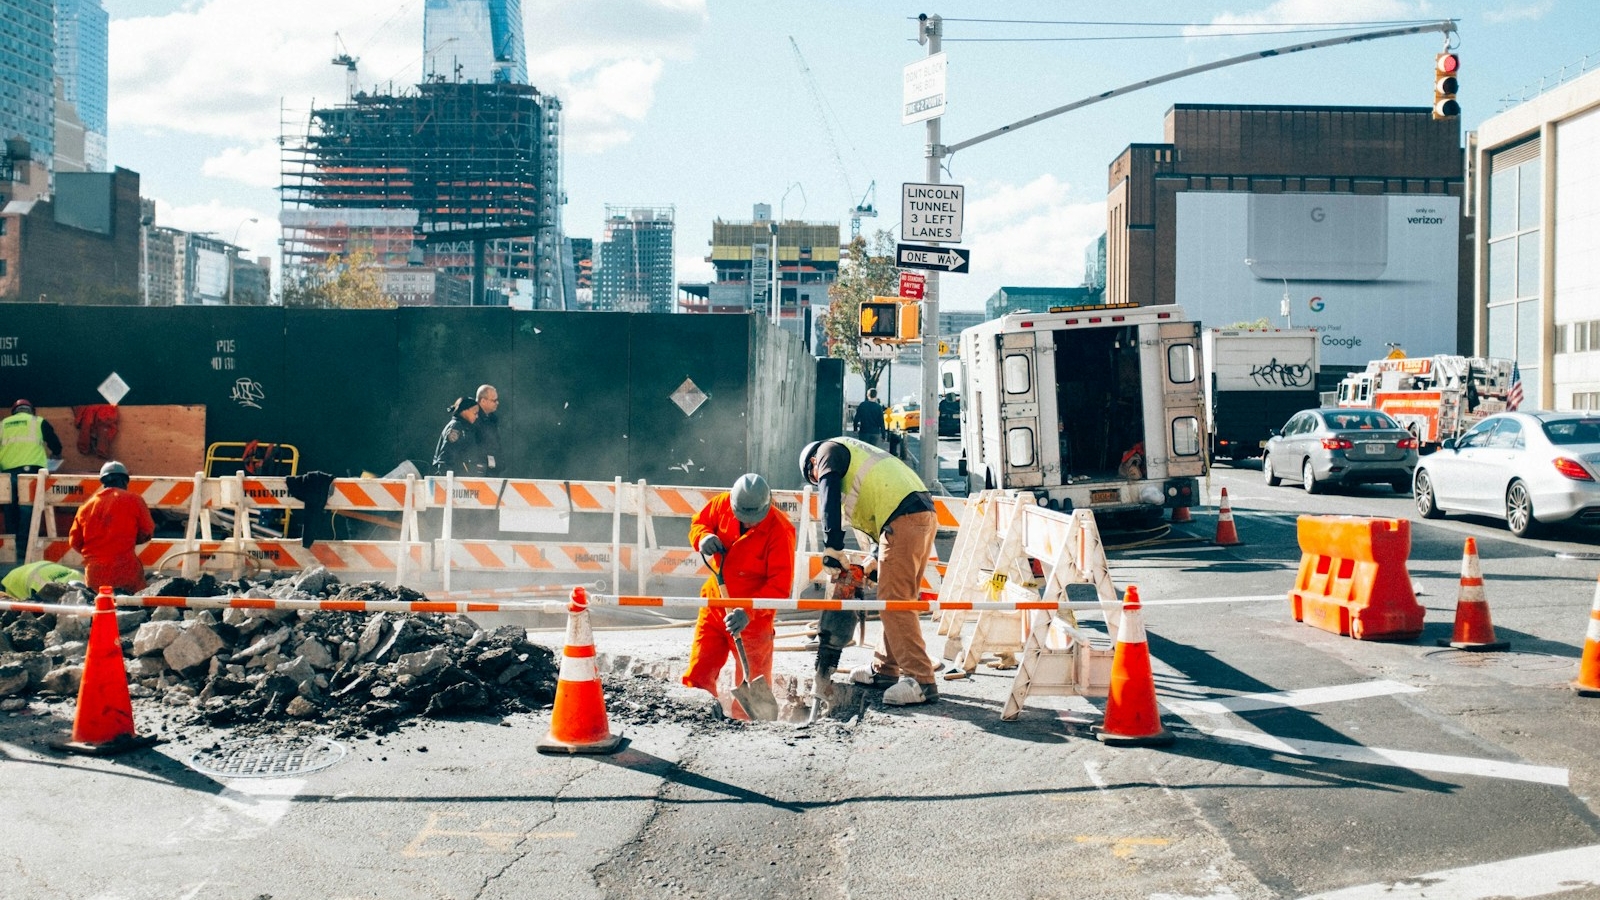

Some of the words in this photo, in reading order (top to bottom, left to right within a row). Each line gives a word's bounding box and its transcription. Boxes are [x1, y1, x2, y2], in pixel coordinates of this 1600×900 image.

[908, 188, 959, 199] LINCOLN
[909, 201, 957, 212] TUNNEL
[911, 214, 918, 223] 3
[925, 214, 954, 224] LEFT
[1310, 207, 1326, 222] G
[1407, 216, 1443, 224] verizon
[912, 227, 952, 237] LANES
[907, 252, 928, 262] ONE
[937, 254, 958, 265] WAY
[1309, 296, 1325, 312] G
[1322, 335, 1362, 348] Google
[1, 353, 28, 366] BILLS
[52, 485, 84, 494] TRIUMPH
[446, 489, 479, 498] RIUMPH
[772, 501, 797, 511] IUMPH
[247, 550, 280, 560] TRIUMPH
